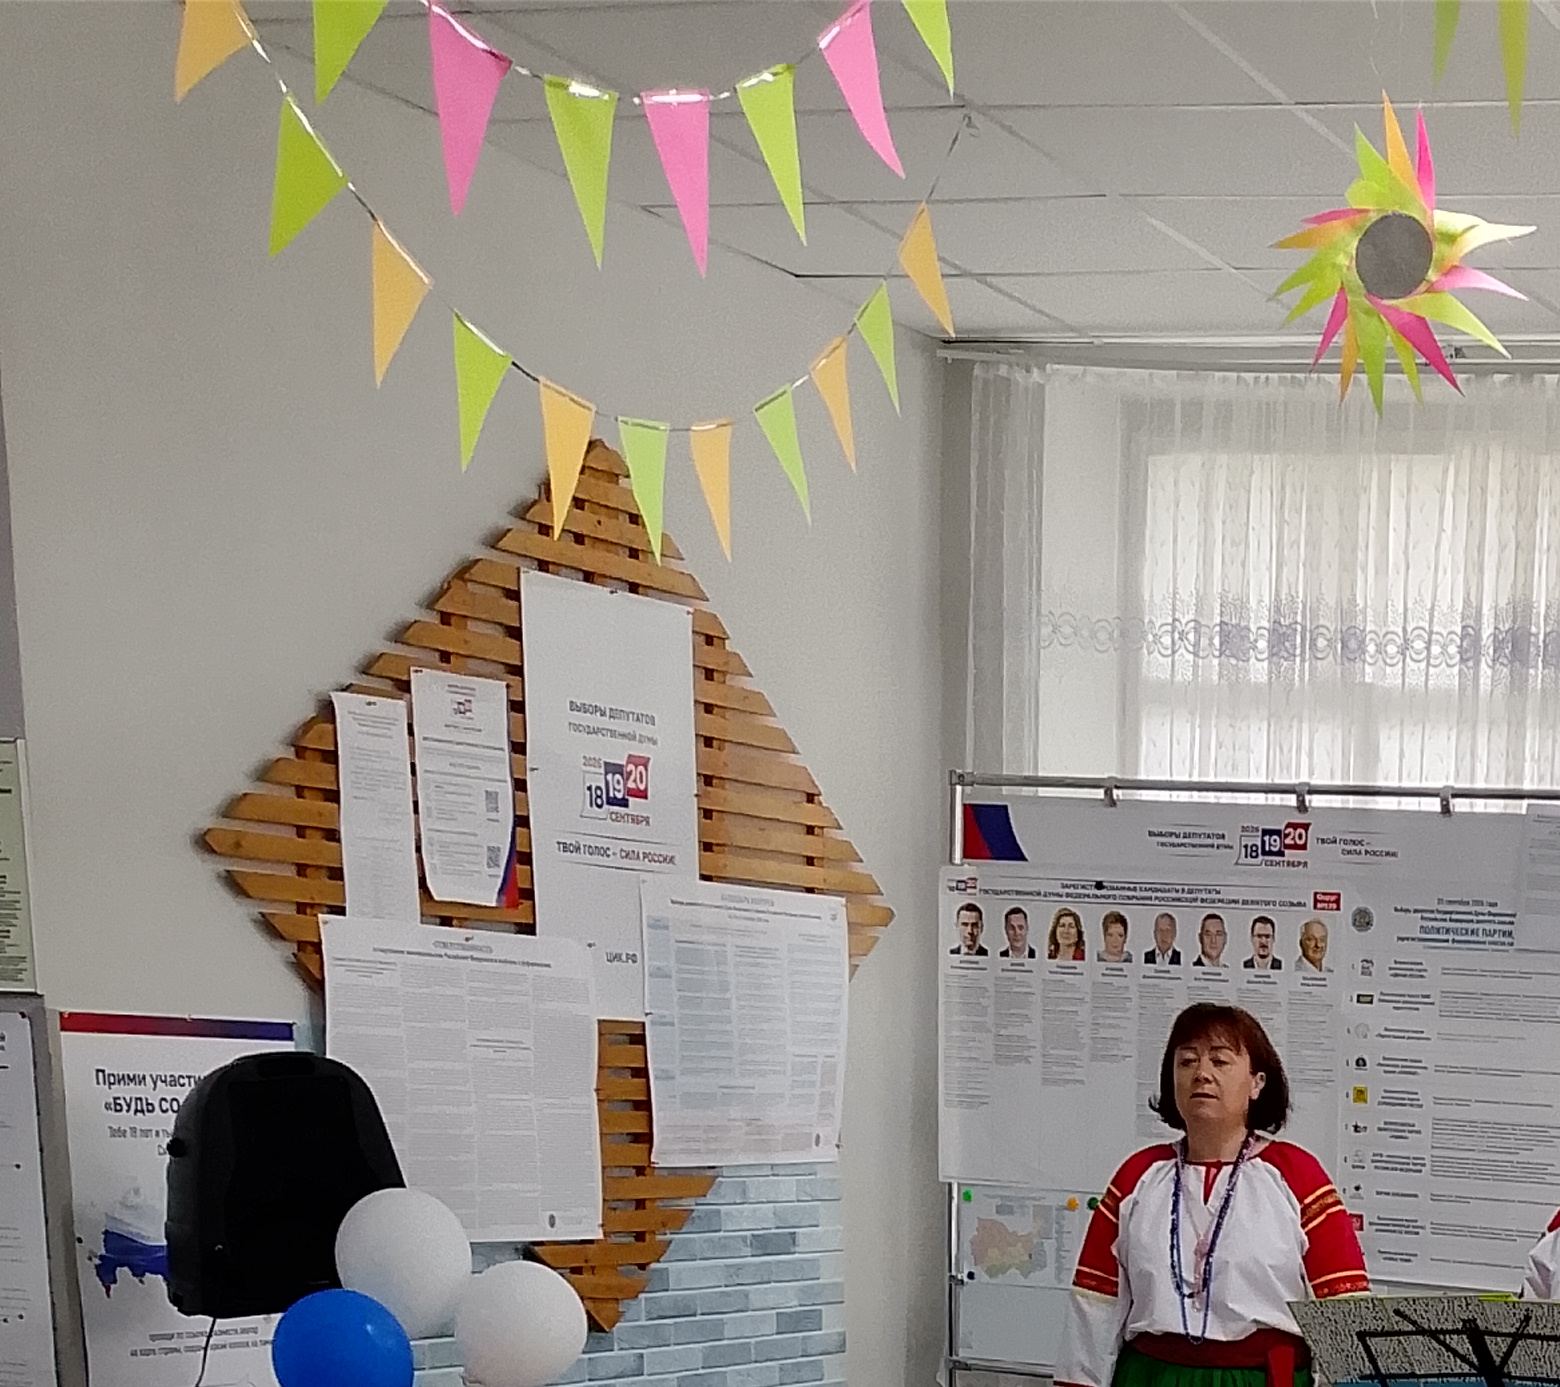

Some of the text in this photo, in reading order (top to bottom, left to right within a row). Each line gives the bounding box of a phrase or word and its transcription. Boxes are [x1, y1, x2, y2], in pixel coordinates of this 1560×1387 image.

[569, 700, 656, 726] ВЫБОРЫ ДЕПУТАТОВ
[606, 773, 624, 799] 19
[626, 765, 647, 791] 20
[586, 784, 604, 809] 18
[609, 811, 651, 827] СЕНТЯБРЯ
[1263, 834, 1281, 851] 19
[1284, 827, 1307, 845] 20
[1316, 836, 1337, 846] ТВОЙ
[556, 840, 582, 855] ТВОЙ
[583, 844, 611, 859] ГОЛОС
[1243, 843, 1259, 859] 18
[1264, 859, 1308, 869] СЕНТЯБРЯ
[95, 1068, 201, 1092] Прими участи
[104, 1096, 156, 1116] «БУДЬ
